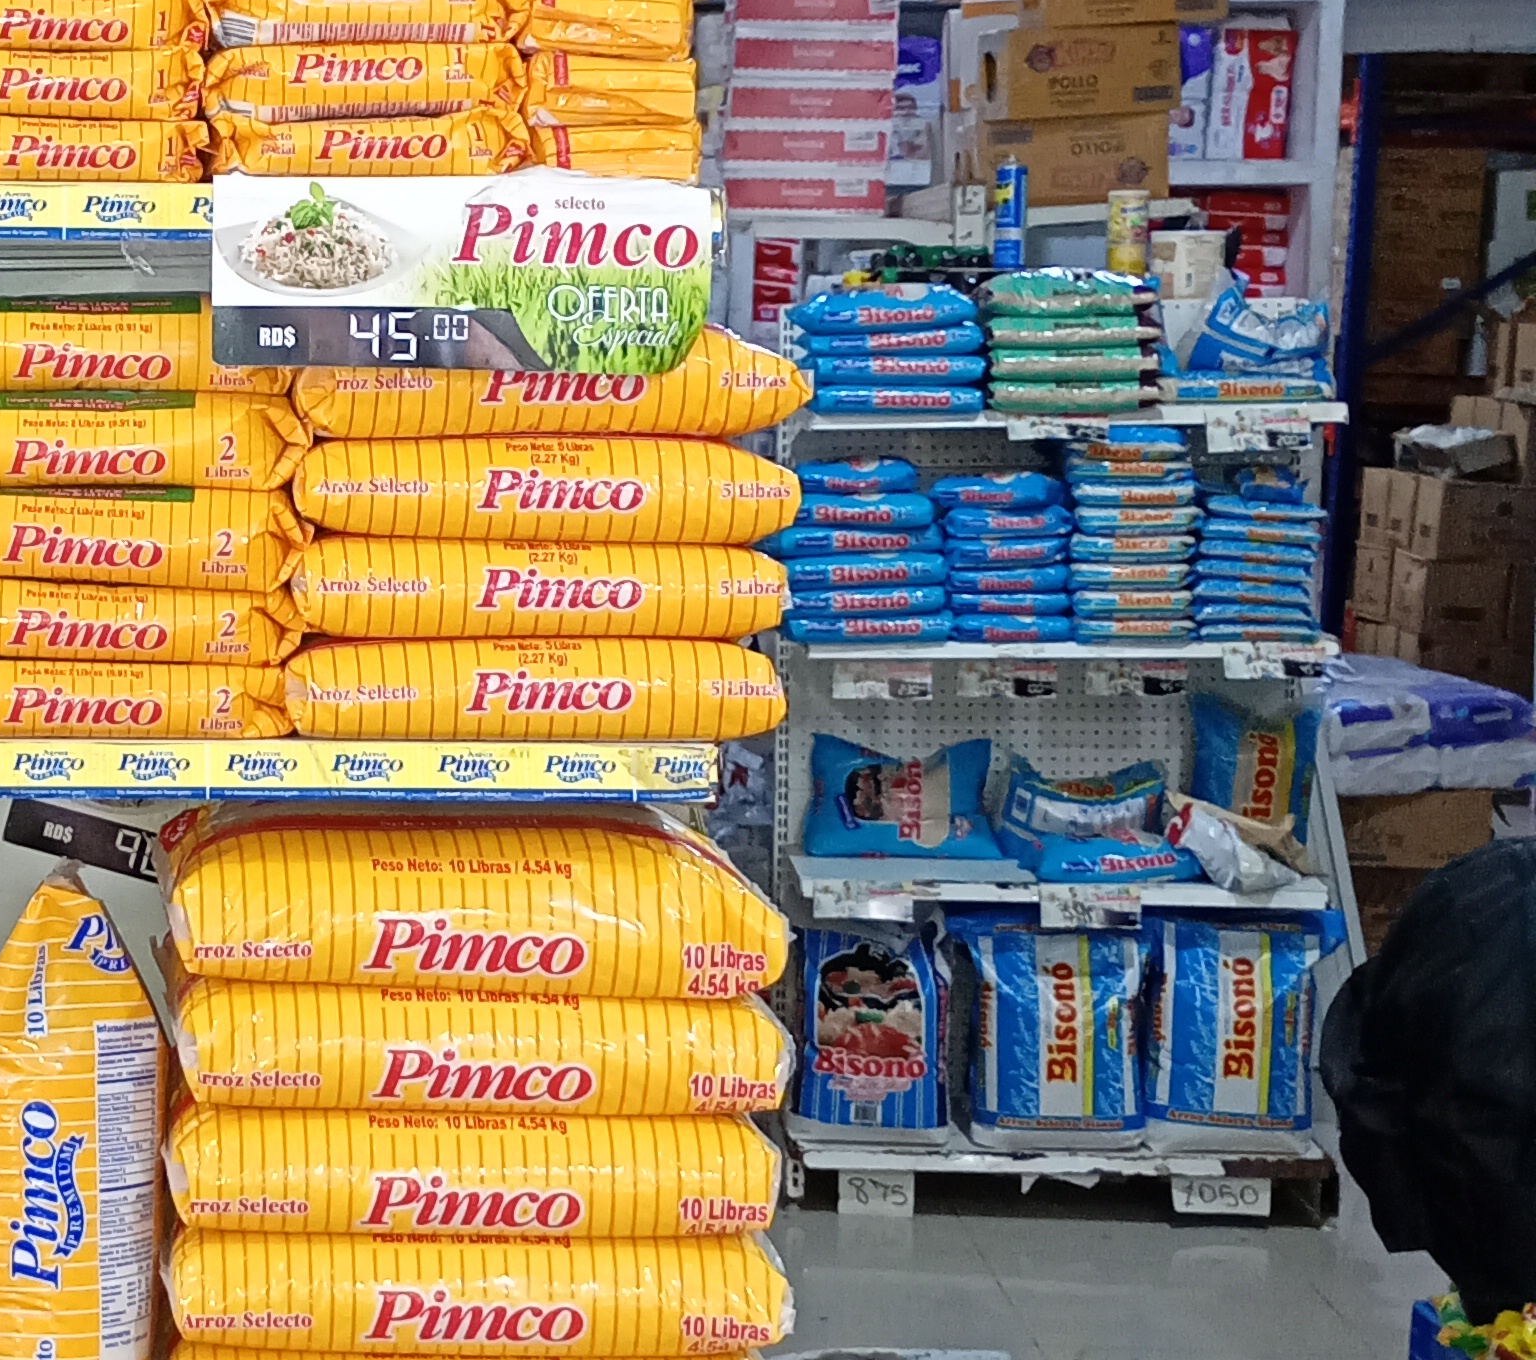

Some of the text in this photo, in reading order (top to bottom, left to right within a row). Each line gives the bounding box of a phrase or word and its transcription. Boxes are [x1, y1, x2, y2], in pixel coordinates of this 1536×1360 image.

[289, 54, 422, 83] Pimco
[3, 135, 136, 169] Pimco
[315, 130, 448, 160] Pimco
[554, 197, 606, 212] selecto
[452, 203, 699, 269] Pimco
[548, 284, 669, 324] OFERTA
[259, 326, 296, 347] RD$
[572, 310, 678, 356] Especial
[13, 344, 171, 378] Pimco
[7, 439, 166, 475] Pimco
[220, 436, 235, 460] 2
[205, 465, 250, 479] Libras
[369, 478, 429, 494] Selecto
[478, 470, 643, 511] Pimco
[721, 483, 790, 498] 5 Libras
[8, 610, 168, 650] Pimco
[4, 687, 163, 726] Pimco
[466, 671, 632, 713] Pimco
[43, 822, 73, 843] RD$
[371, 859, 572, 878] Peso Neto: 10 Libras 4.54 kg
[364, 918, 585, 975] Pimco
[27, 946, 45, 1035] 10 Libras
[1046, 963, 1077, 1083] Bisonó
[1223, 958, 1256, 1079] Bisonó
[373, 1049, 594, 1102] Pimco
[814, 1044, 926, 1079] Bisonó
[11, 1101, 59, 1290] Pimco
[61, 1140, 83, 1250] PREMIUM
[360, 1176, 581, 1227] Pimco
[847, 1177, 907, 1205] 875
[1182, 1181, 1259, 1207] 1050
[364, 1290, 584, 1342] Pimco
